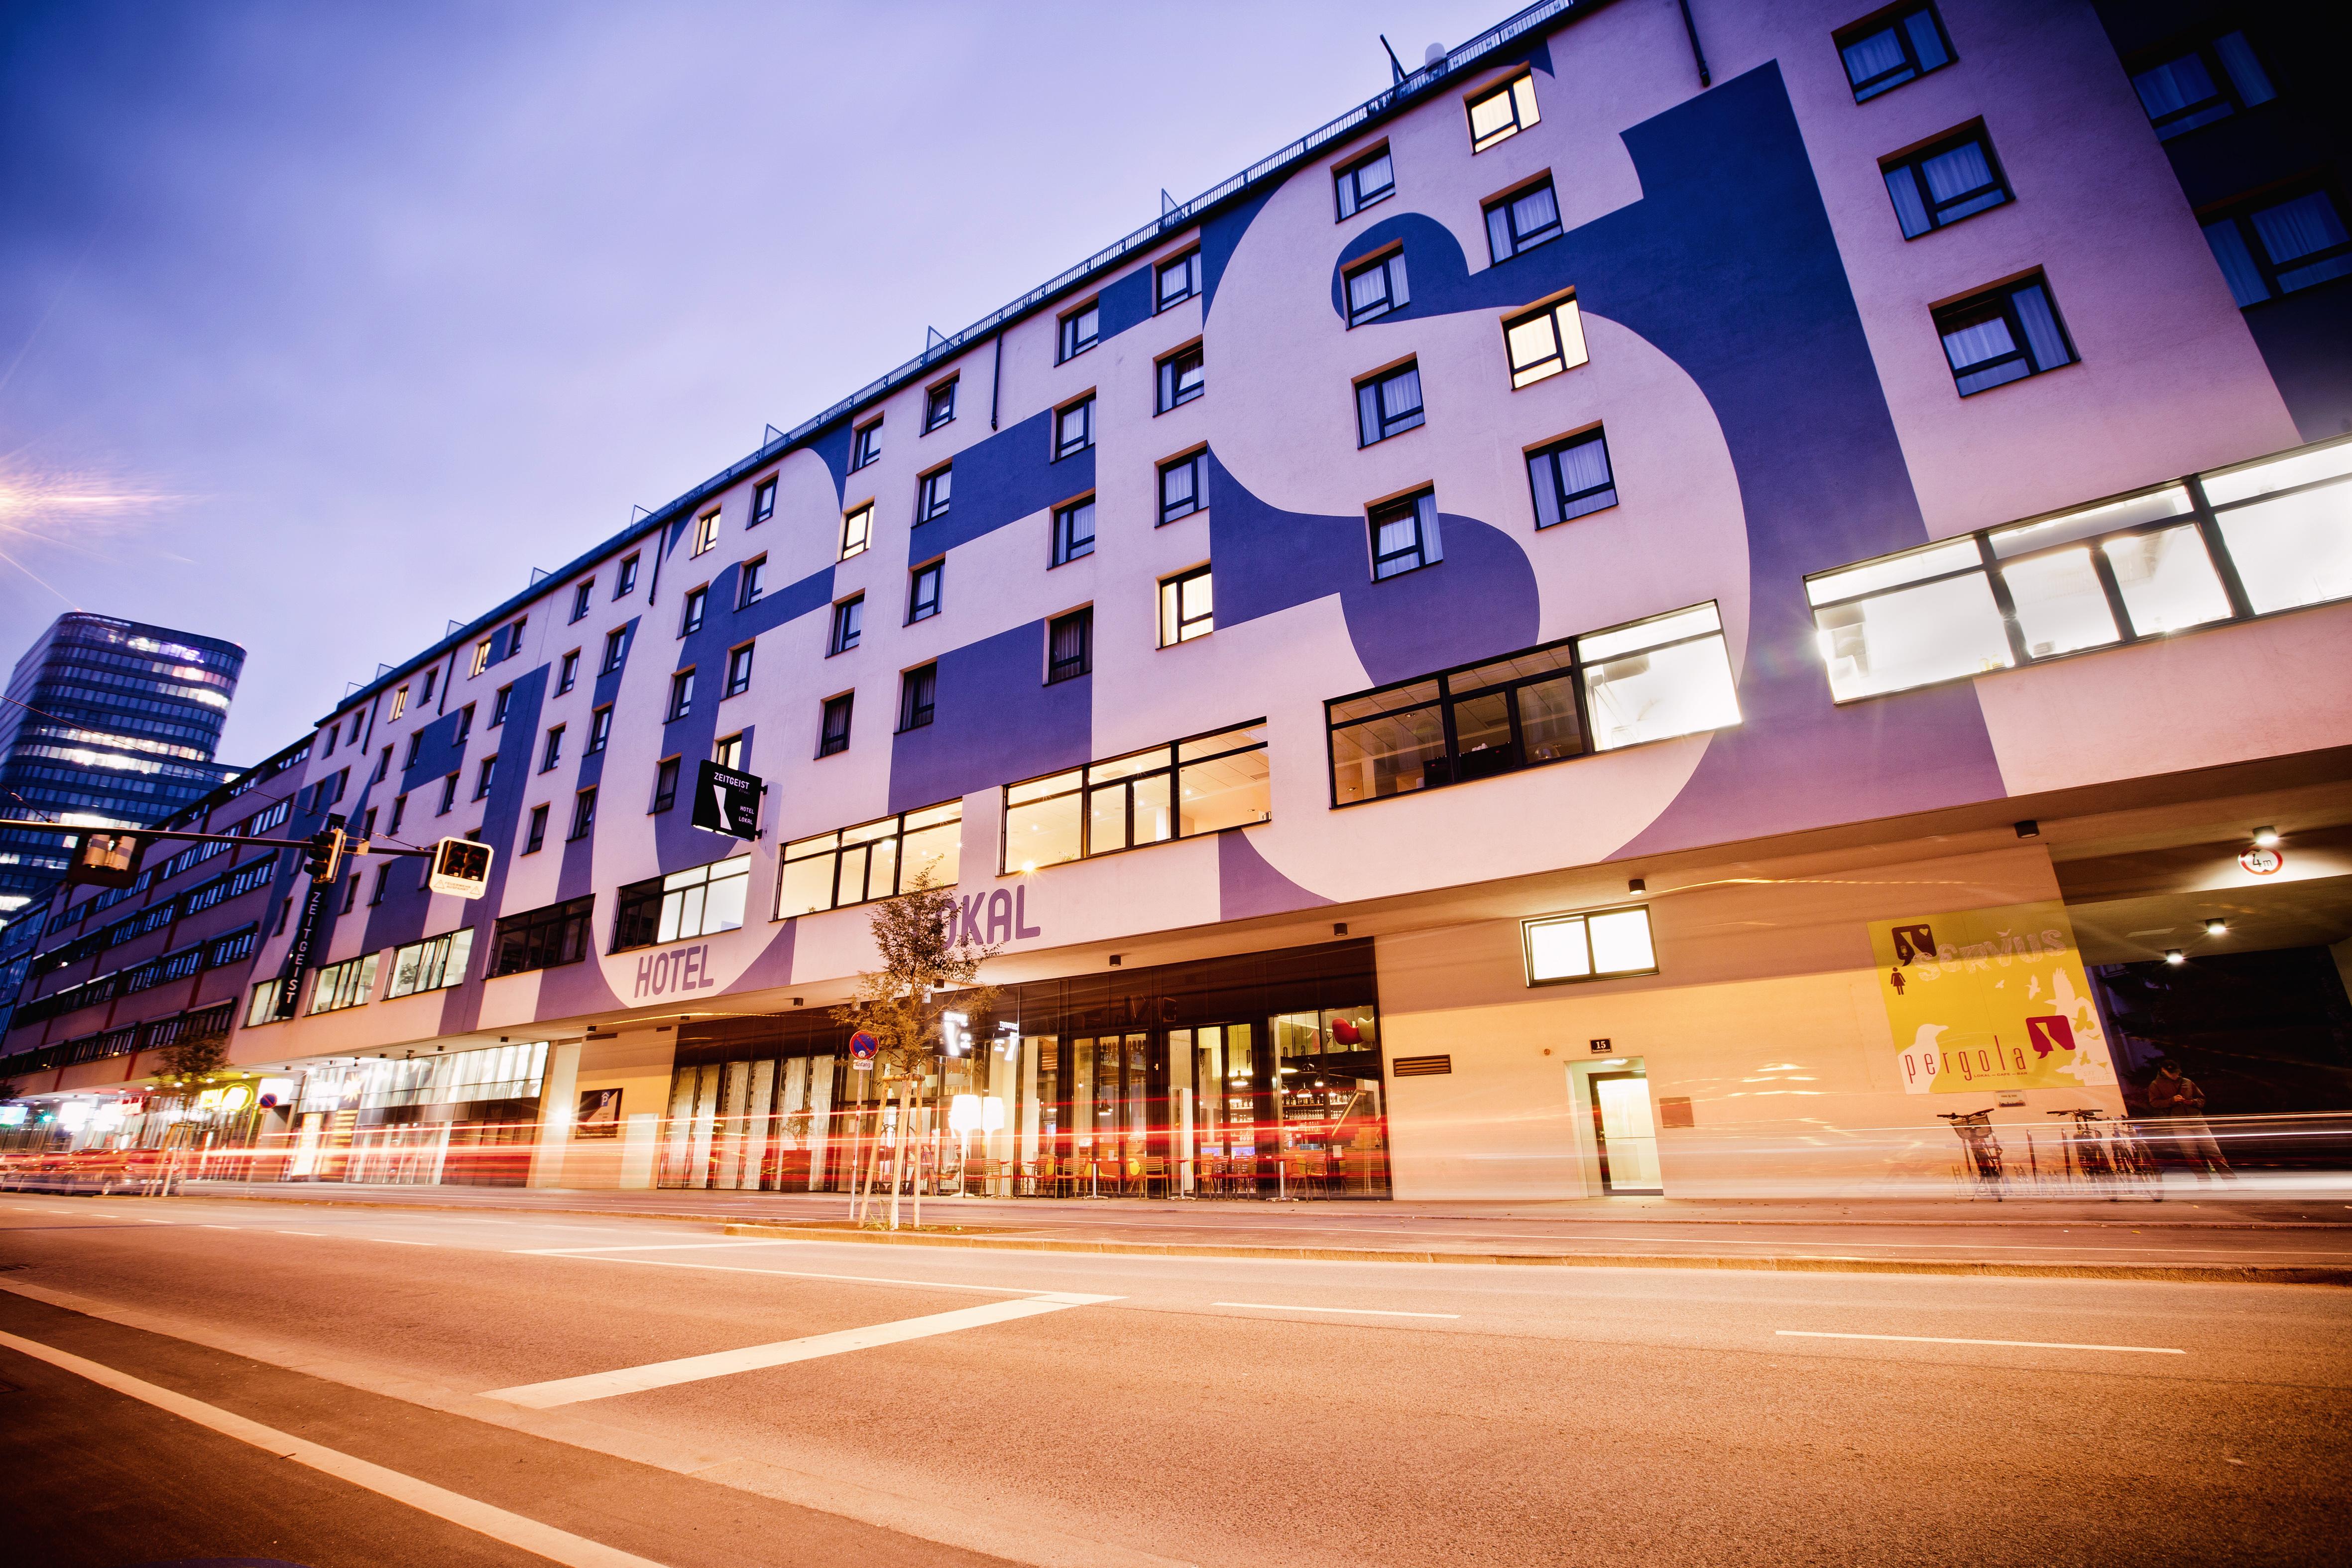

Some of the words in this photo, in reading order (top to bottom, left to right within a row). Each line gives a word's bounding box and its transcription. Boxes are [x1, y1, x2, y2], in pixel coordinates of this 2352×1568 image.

[714, 772, 750, 789] ZEITGEIST
[739, 816, 753, 825] LOKAL
[740, 806, 754, 814] HOTEL
[285, 892, 322, 1003] ZEITGEIST
[634, 944, 714, 998] HOTEL
[1913, 930, 2066, 981] SERVUS
[1904, 1035, 2026, 1084] pergola
